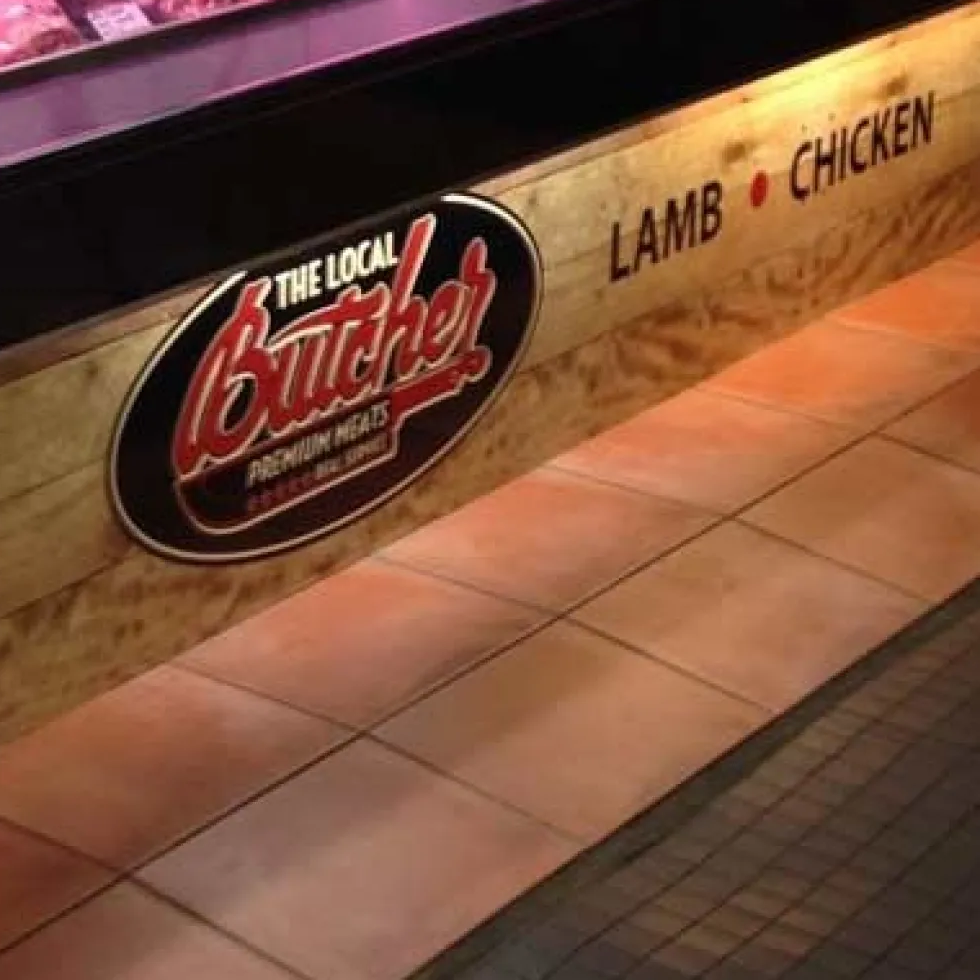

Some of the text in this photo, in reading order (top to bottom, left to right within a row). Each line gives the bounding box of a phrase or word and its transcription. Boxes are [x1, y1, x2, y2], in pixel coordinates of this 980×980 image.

[608, 90, 936, 283] LAMB CHICKEN
[274, 231, 400, 309] THE LOCAL
[172, 213, 497, 485] Butcher
[246, 431, 332, 487] PREMIUM
[334, 399, 391, 447] MEATS
